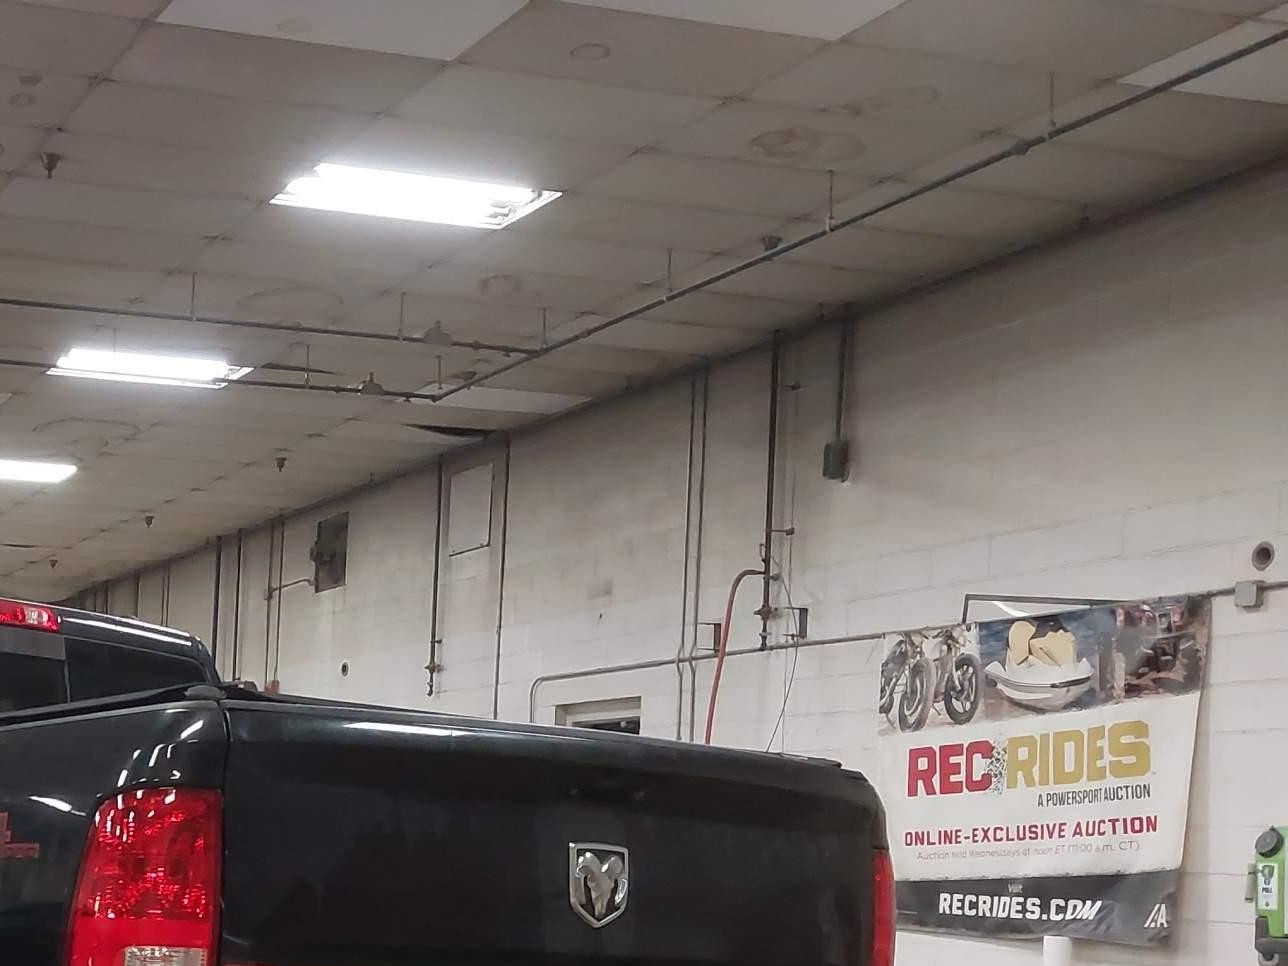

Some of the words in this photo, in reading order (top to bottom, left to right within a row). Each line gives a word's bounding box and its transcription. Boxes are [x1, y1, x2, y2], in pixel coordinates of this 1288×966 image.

[1006, 720, 1152, 789] RIDES
[1037, 793, 1045, 807] A
[1046, 788, 1102, 807] POWERSPORT
[1103, 783, 1151, 802] AUCTION
[904, 822, 1067, 847] ONLINE-EXCLUSIVE
[1072, 815, 1158, 838] AUCTION
[917, 850, 950, 860] Auction
